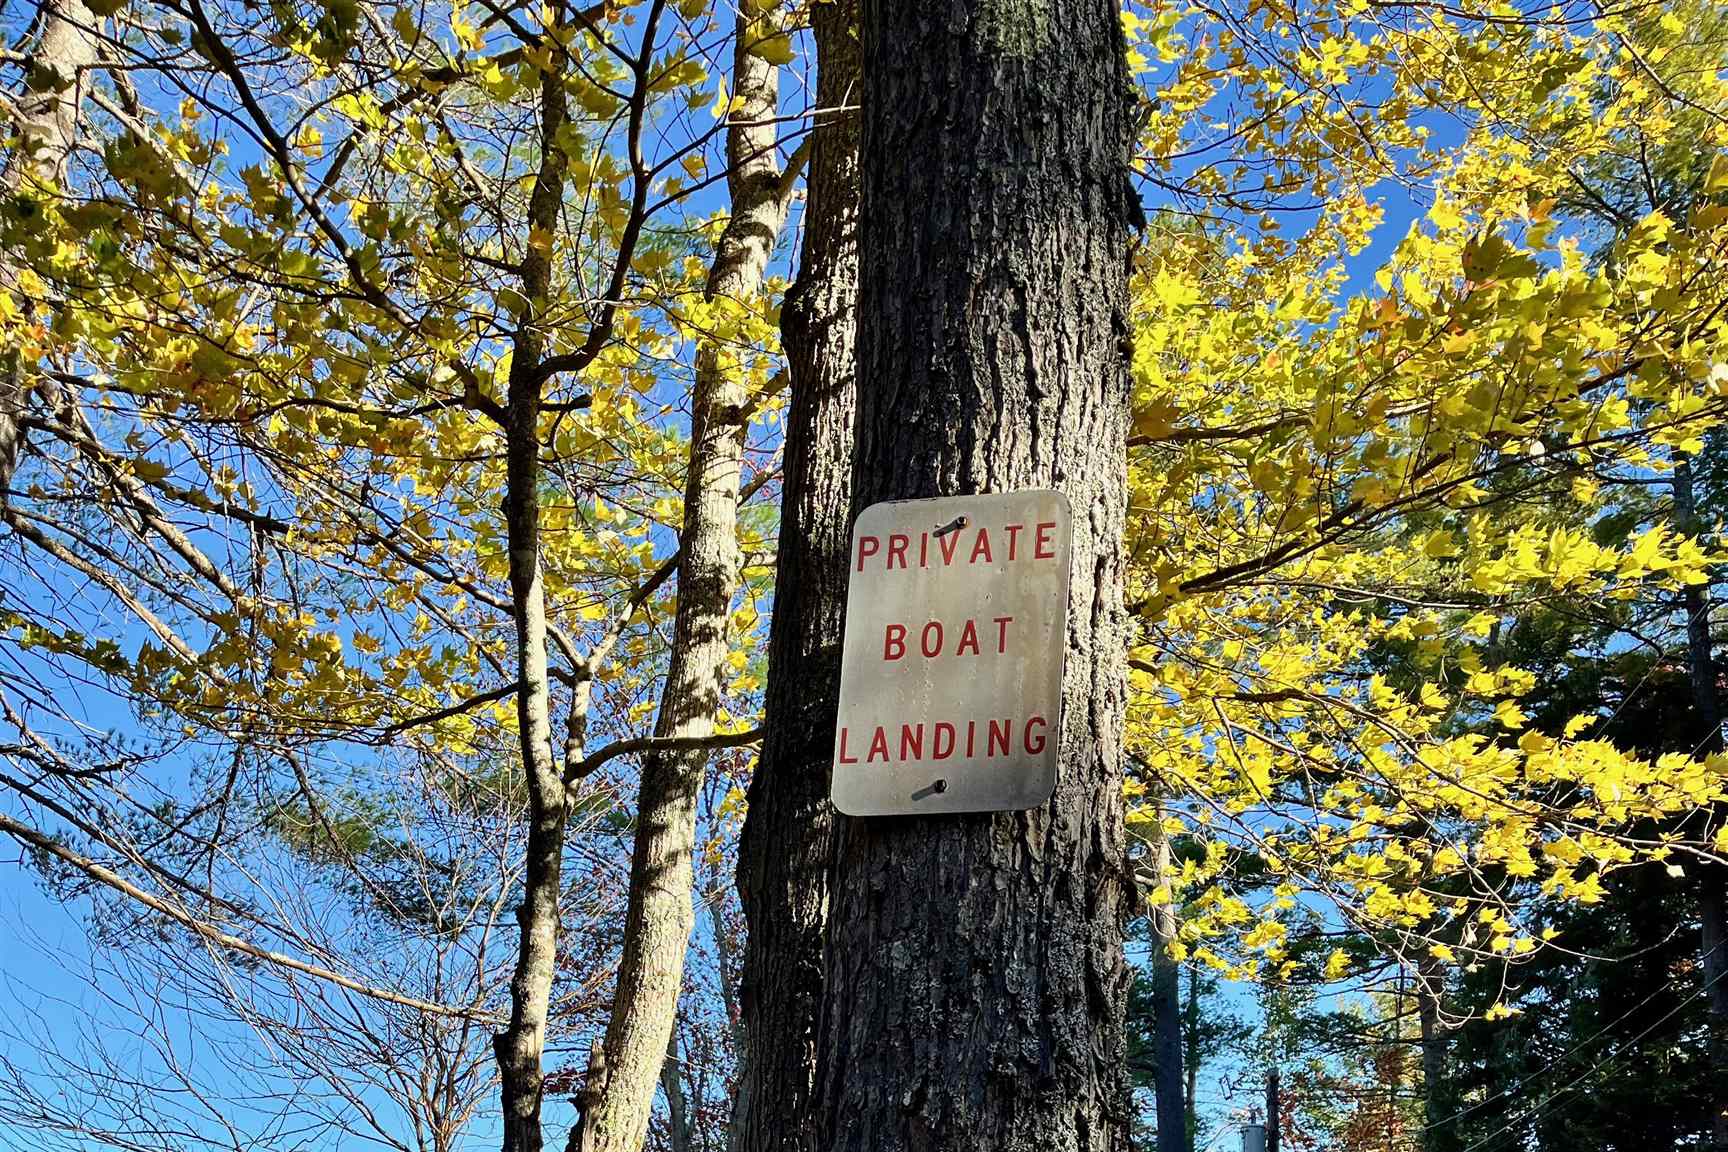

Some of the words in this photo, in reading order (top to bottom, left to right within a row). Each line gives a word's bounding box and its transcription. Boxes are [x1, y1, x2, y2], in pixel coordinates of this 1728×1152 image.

[857, 522, 1056, 572] PRIVATE
[884, 617, 1013, 660] BOAT
[839, 717, 1047, 764] LANDING
